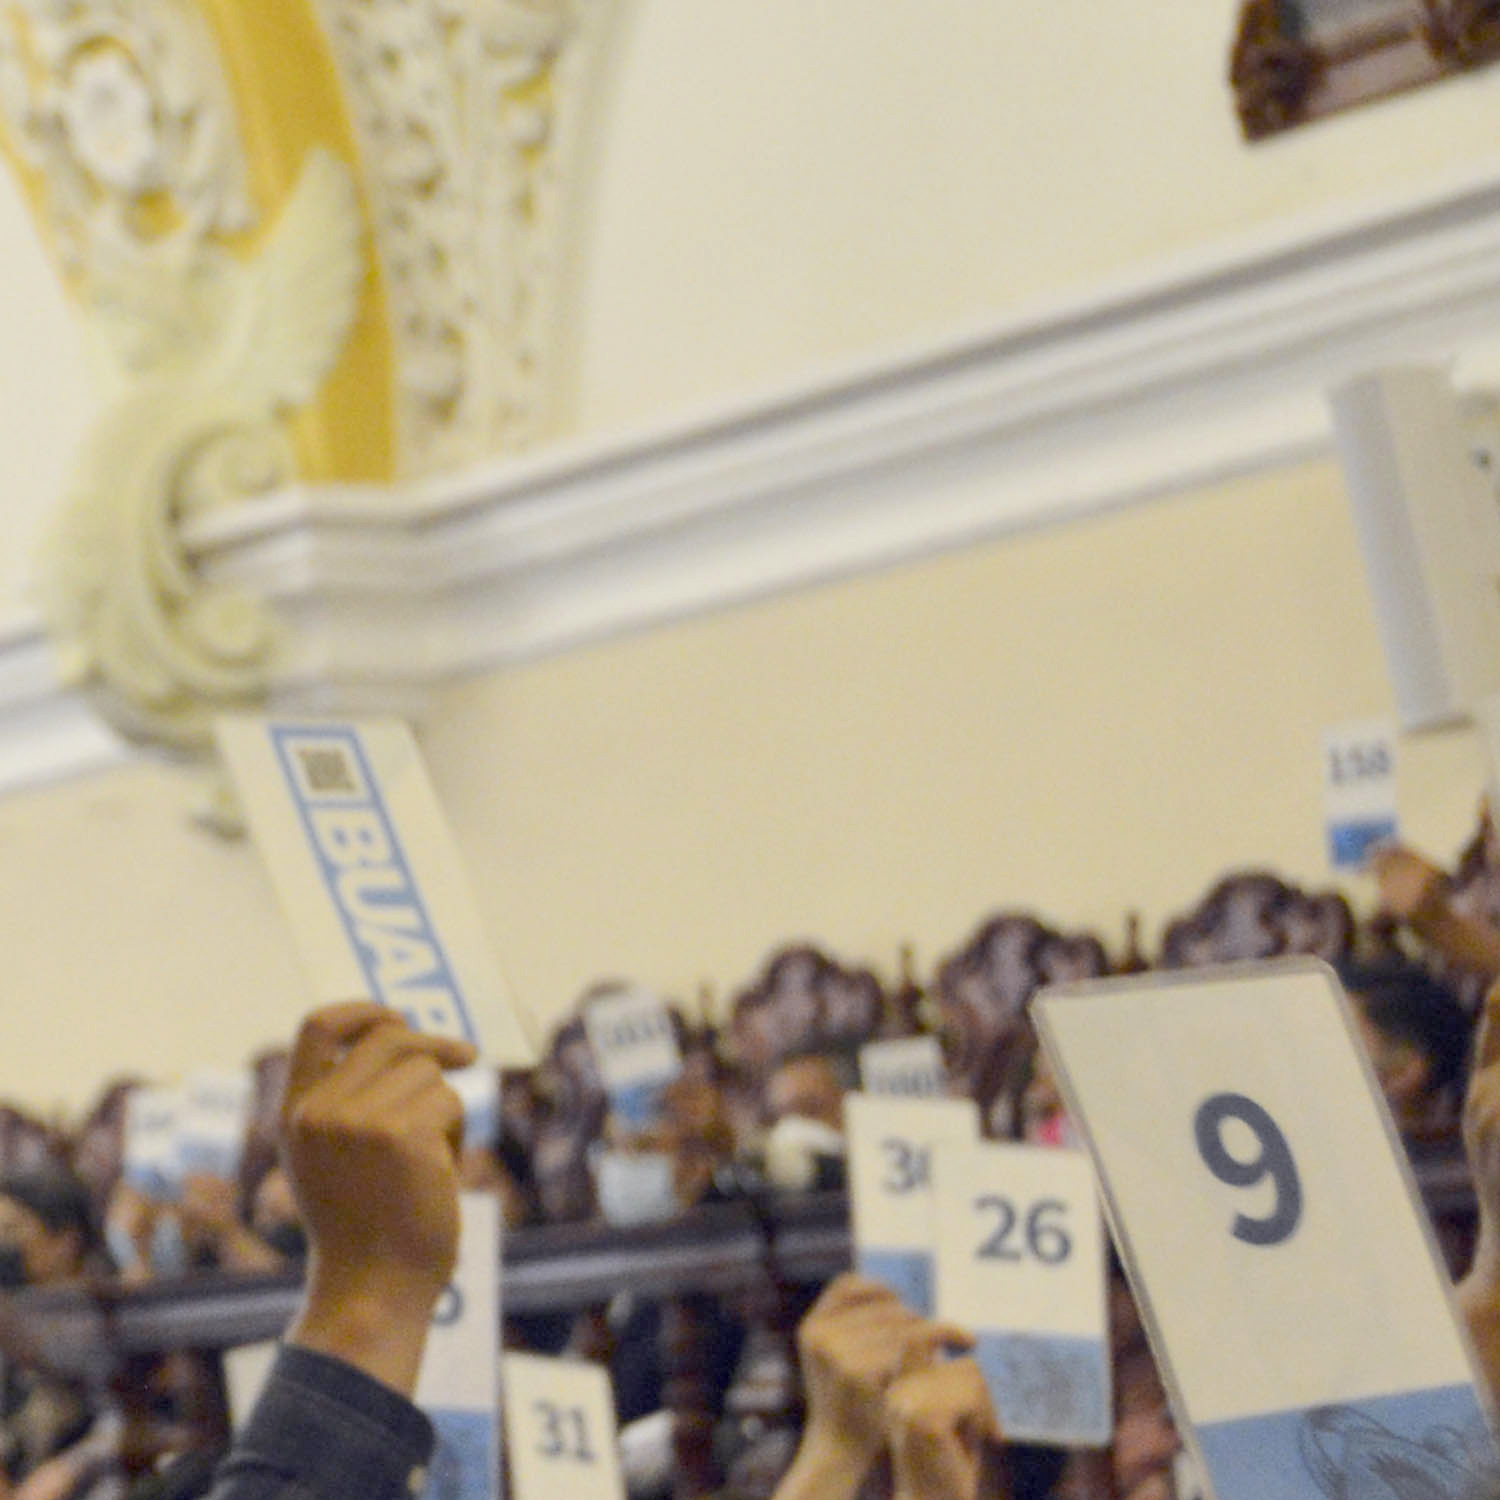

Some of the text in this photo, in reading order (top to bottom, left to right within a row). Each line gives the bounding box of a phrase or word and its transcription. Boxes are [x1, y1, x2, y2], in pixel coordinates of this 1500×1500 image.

[1194, 1093, 1303, 1246] 9
[977, 1197, 1072, 1265] 26
[536, 1401, 595, 1465] 31
